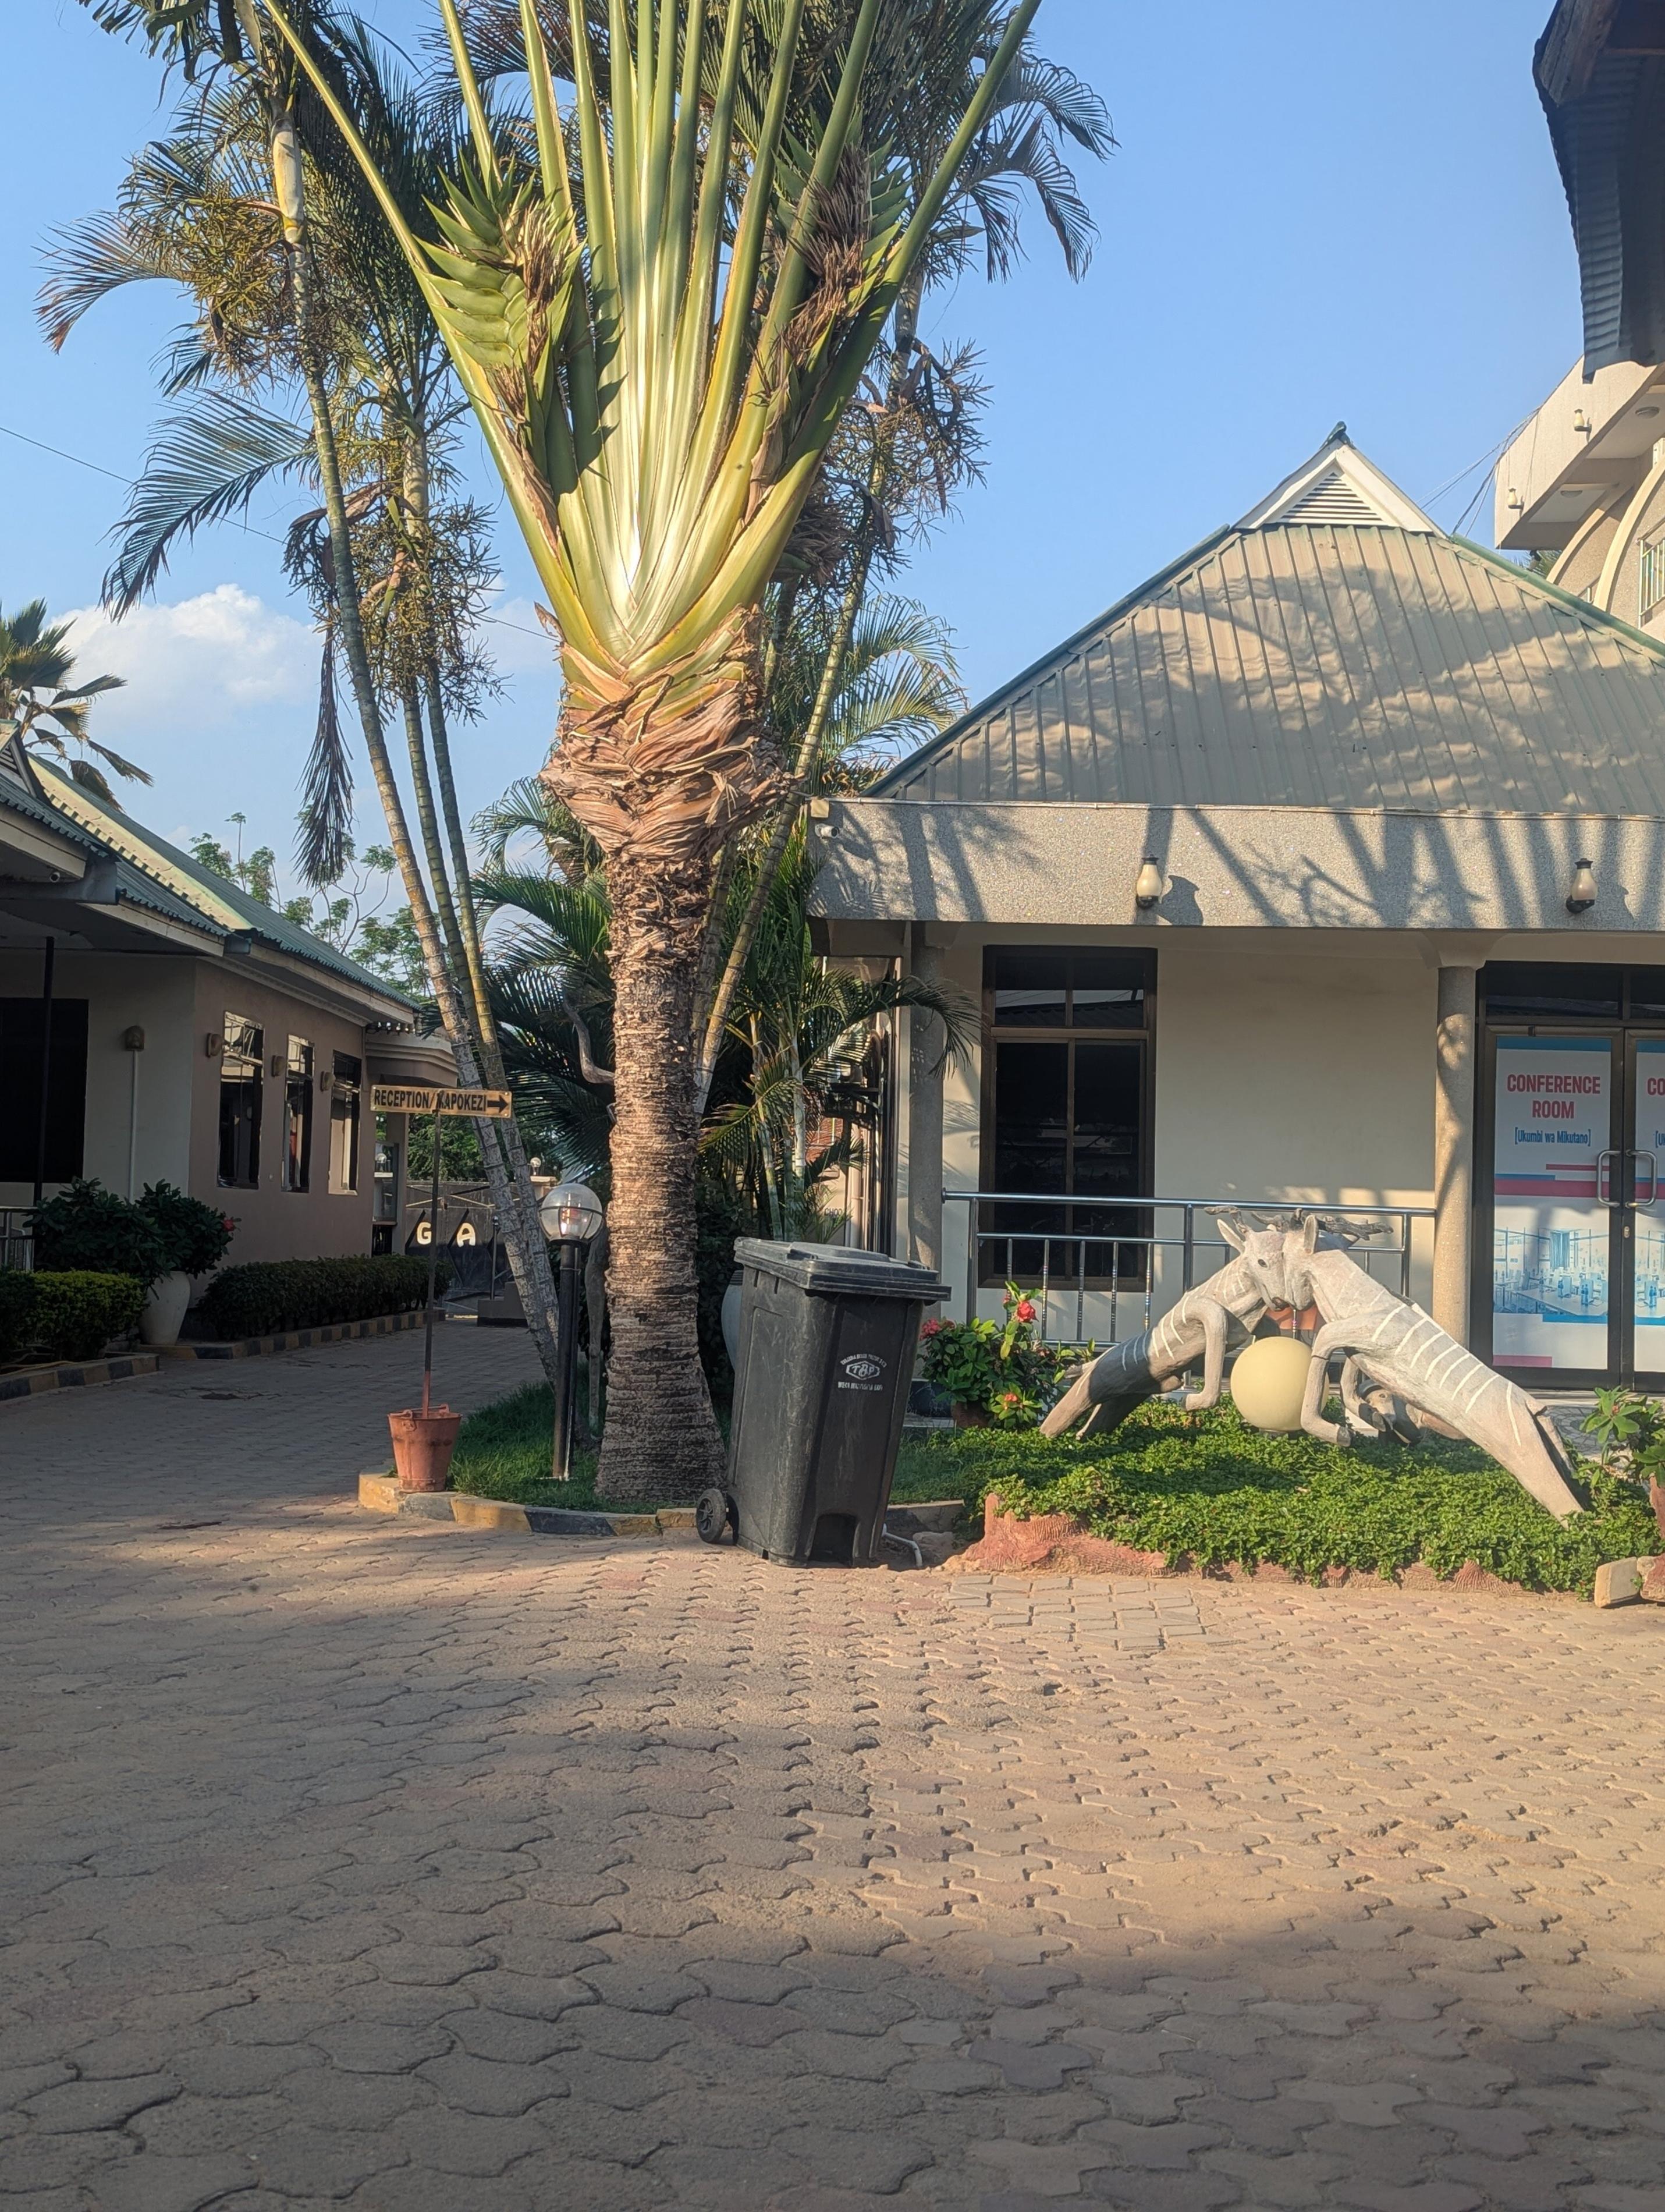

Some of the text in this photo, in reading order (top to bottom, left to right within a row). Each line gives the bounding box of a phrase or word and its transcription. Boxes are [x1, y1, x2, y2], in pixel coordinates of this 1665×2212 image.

[1507, 1074, 1600, 1094] CONFERENCE
[1532, 1100, 1574, 1119] ROOM
[1514, 1126, 1591, 1147] [Ukumbi wa Mikutano]
